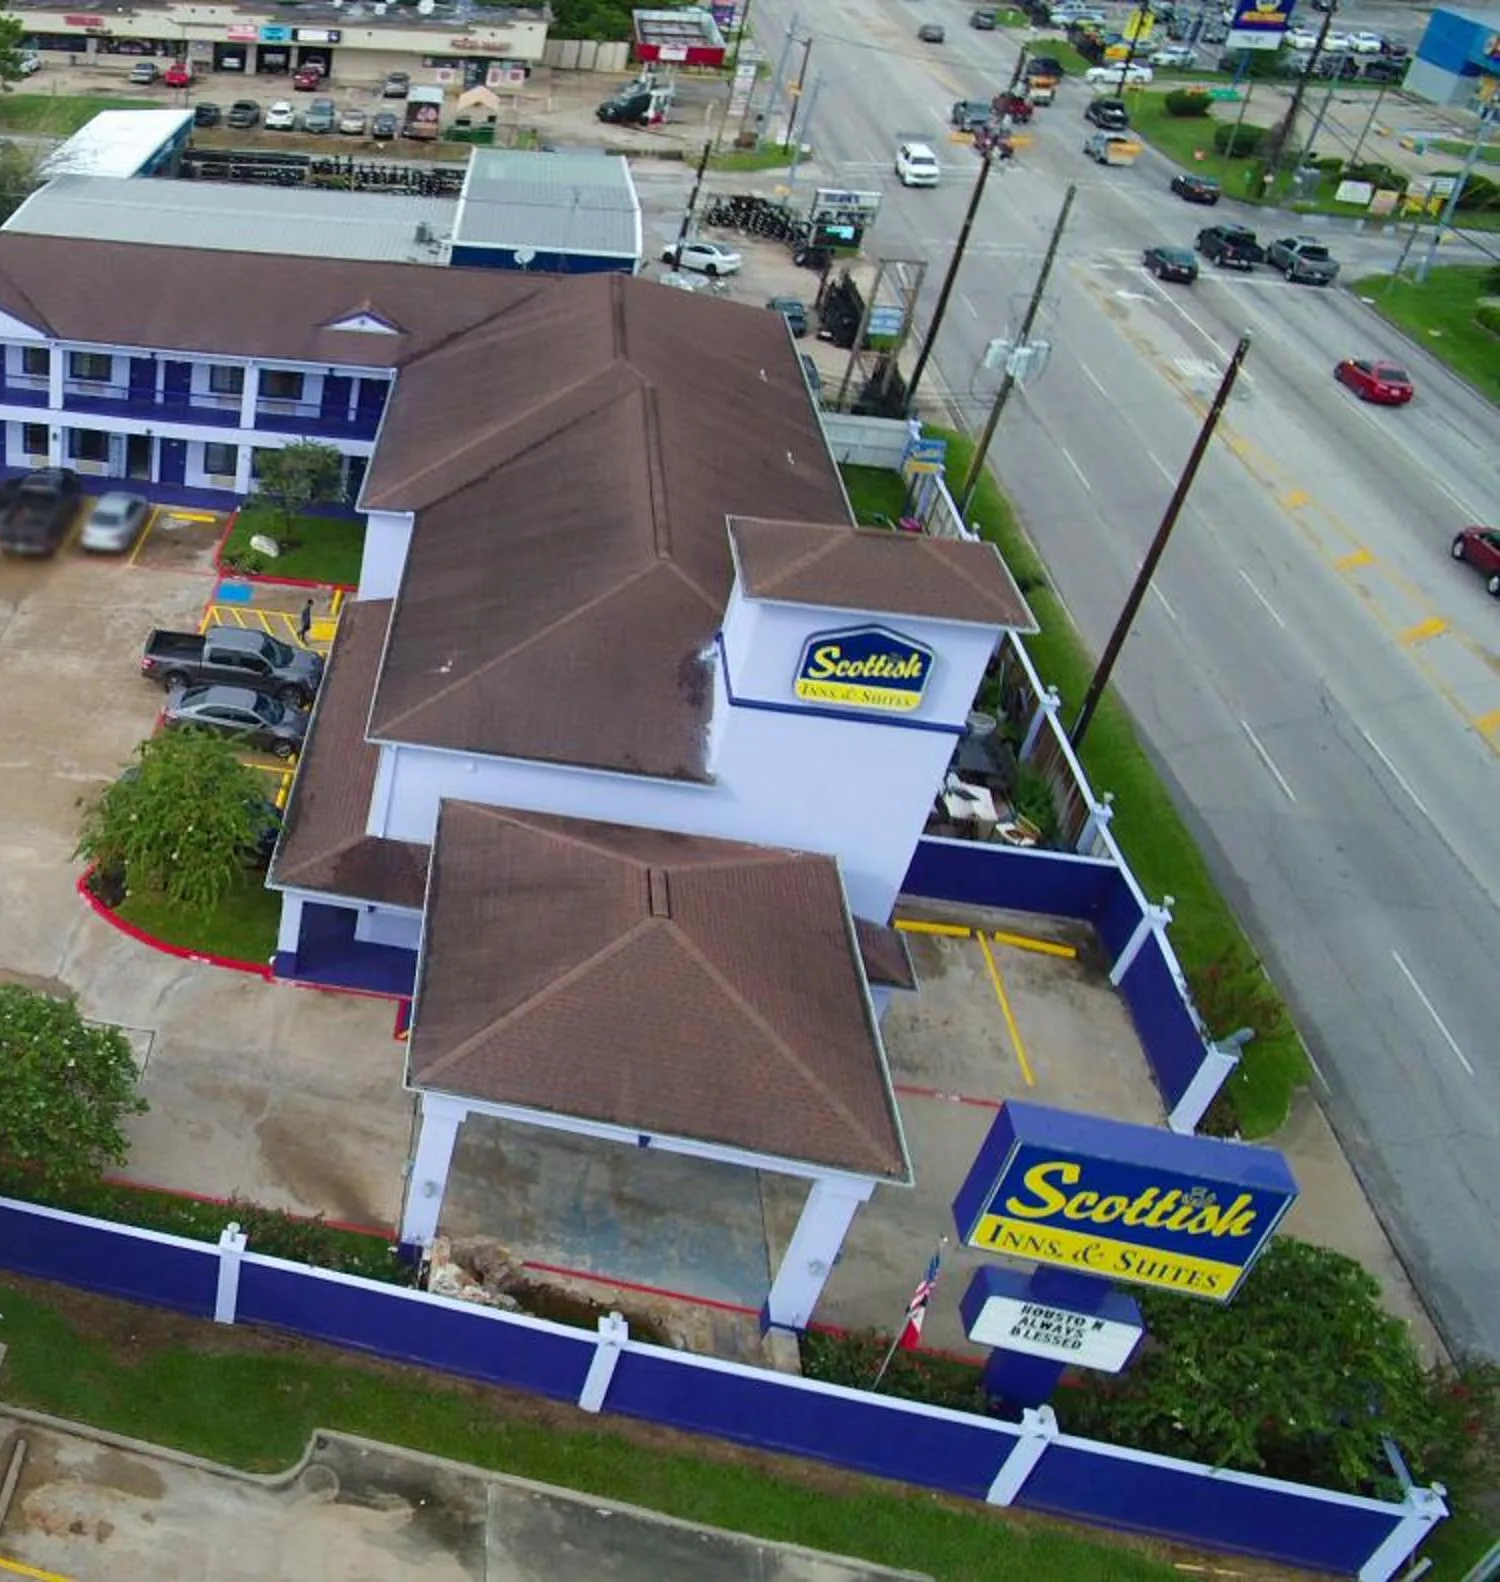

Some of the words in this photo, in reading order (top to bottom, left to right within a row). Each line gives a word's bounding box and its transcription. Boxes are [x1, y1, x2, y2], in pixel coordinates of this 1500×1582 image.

[808, 645, 923, 679] Scottish
[1006, 1161, 1257, 1237] Scottish
[1072, 1243, 1105, 1264] &
[1112, 1250, 1221, 1290] SUITES
[1018, 1316, 1084, 1339] ALWAYS
